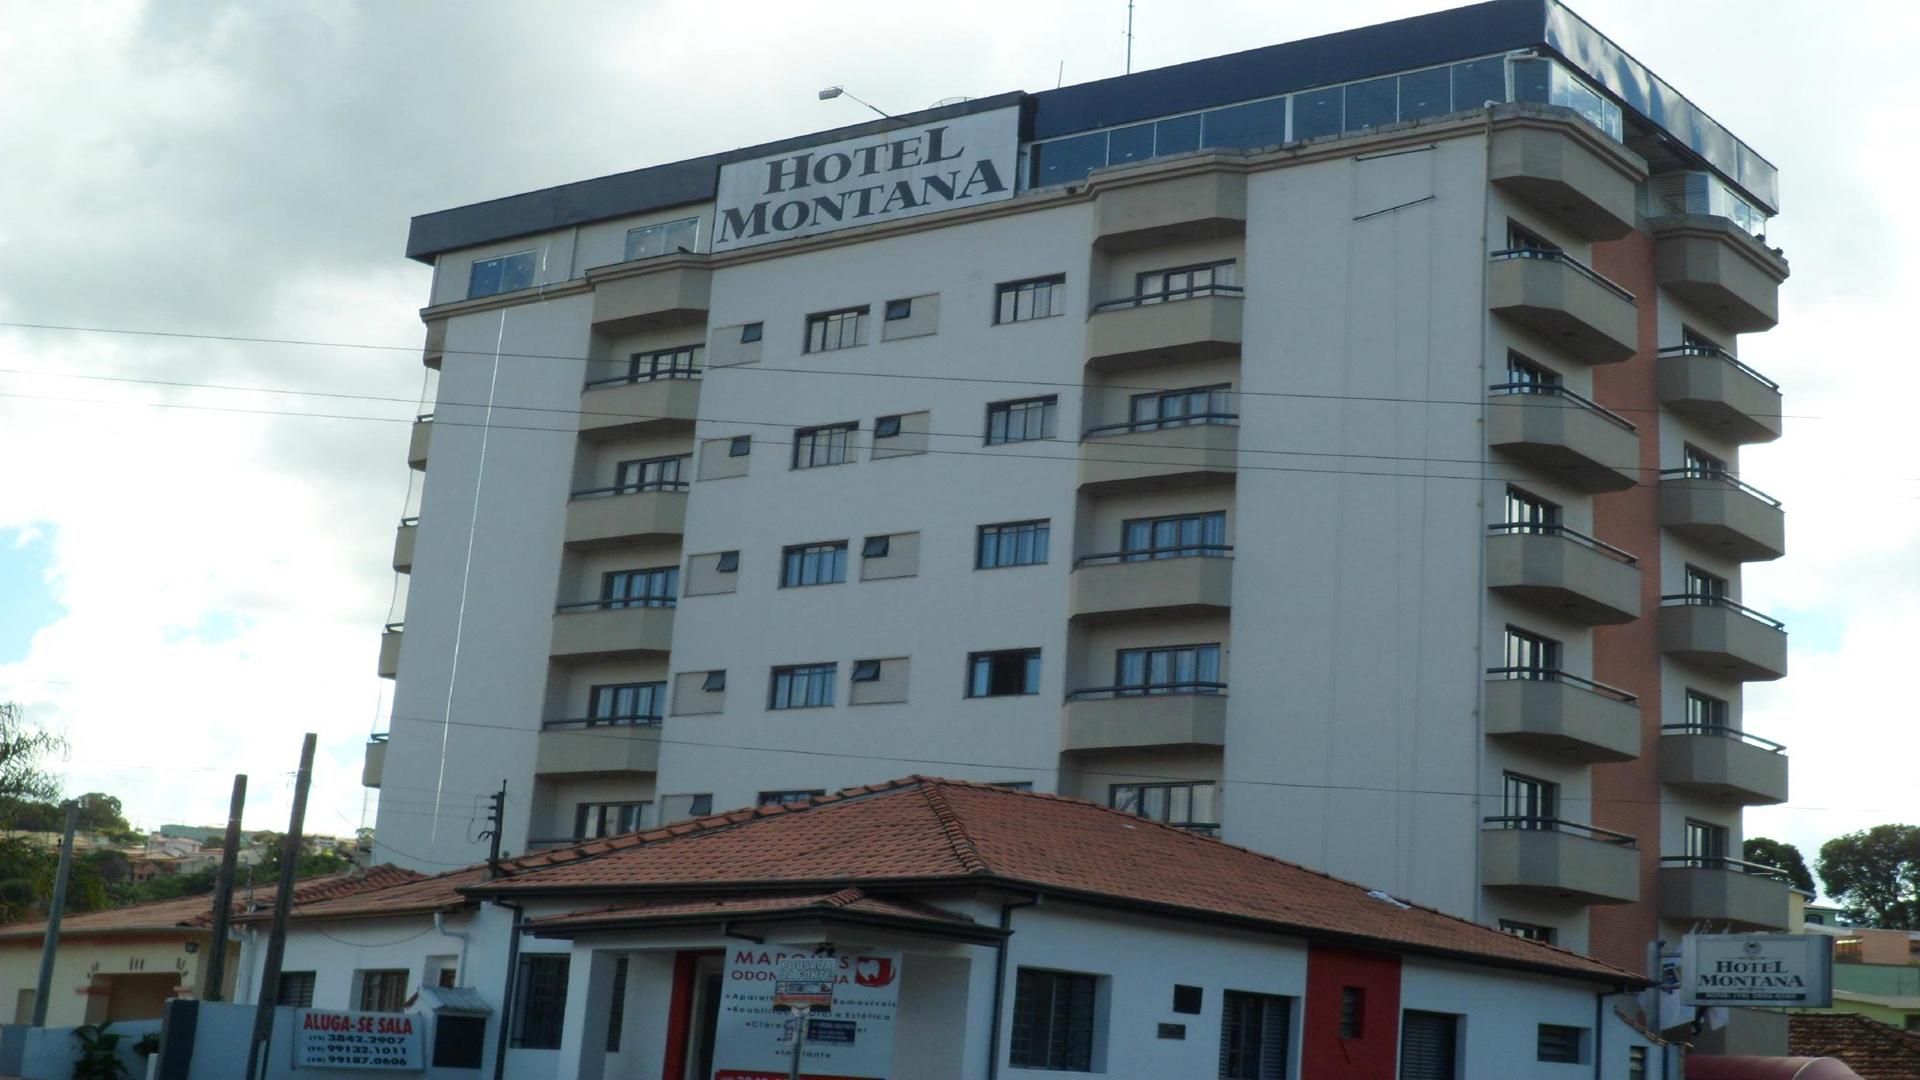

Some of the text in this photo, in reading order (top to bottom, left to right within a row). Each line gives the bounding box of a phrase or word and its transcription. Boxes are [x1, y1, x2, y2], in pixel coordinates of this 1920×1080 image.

[763, 125, 965, 195] HOTEL
[716, 159, 1008, 244] MONTANA
[1715, 960, 1788, 973] HOTEL
[731, 970, 849, 985] ODONIA
[1698, 974, 1804, 987] MONTANA
[303, 1013, 413, 1035] ALUGA-SE SALA
